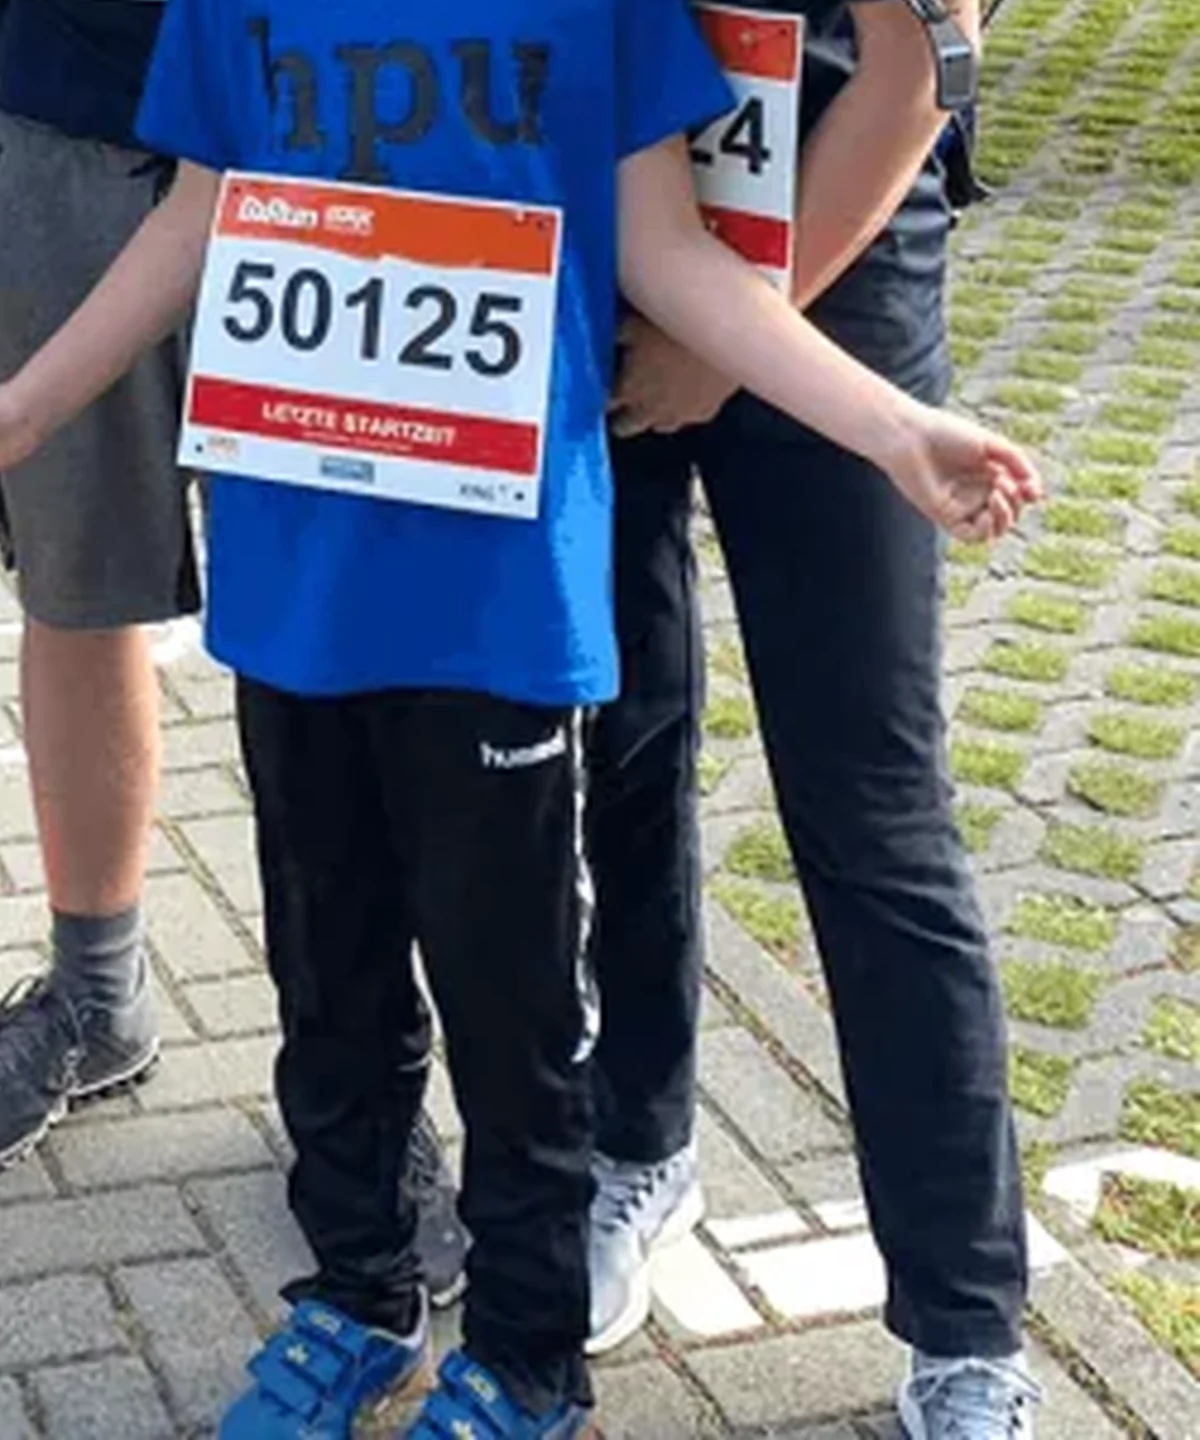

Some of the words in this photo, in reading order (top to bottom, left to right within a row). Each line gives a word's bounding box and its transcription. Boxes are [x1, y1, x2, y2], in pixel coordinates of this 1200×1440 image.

[249, 18, 549, 181] hpu
[691, 96, 771, 176] 4
[224, 262, 523, 377] 50125
[262, 401, 337, 429] LETZTE
[343, 413, 457, 447] STARTZEIT
